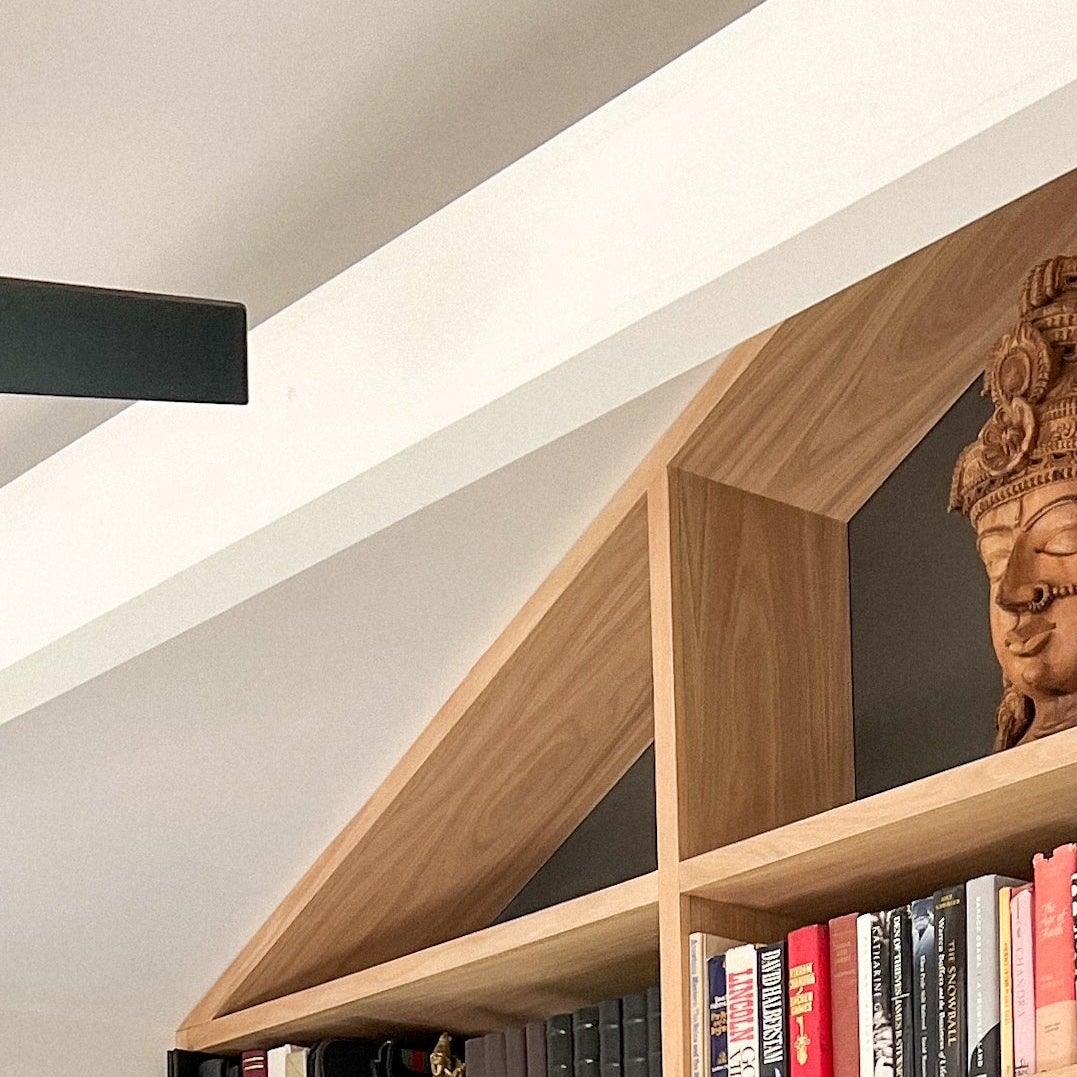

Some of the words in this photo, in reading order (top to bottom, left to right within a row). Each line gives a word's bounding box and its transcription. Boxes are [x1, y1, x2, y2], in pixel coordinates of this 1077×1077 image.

[894, 916, 902, 938] DEN
[760, 948, 784, 986] DAVID
[728, 968, 754, 1044] LINCOLN
[762, 985, 784, 1064] HALBERSTAM
[948, 966, 958, 1046] SNOWBALL
